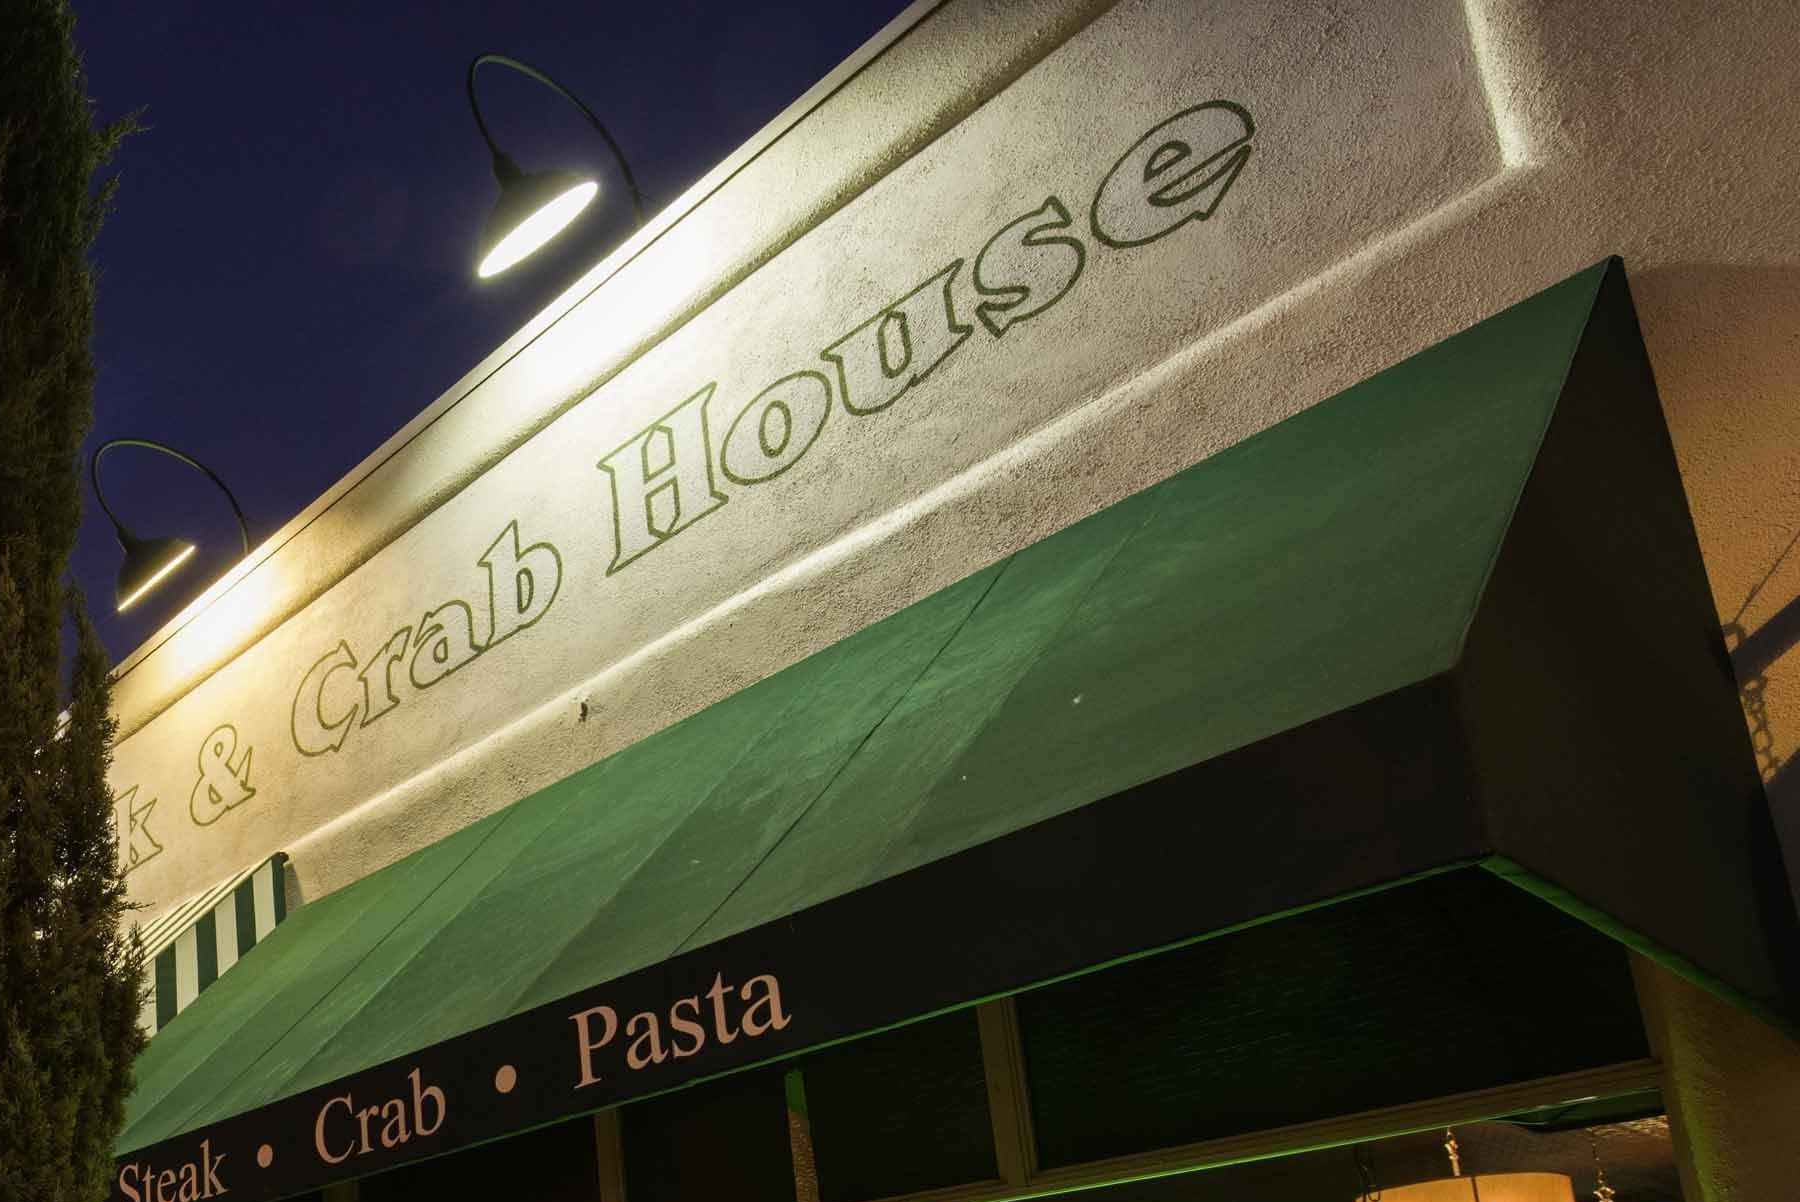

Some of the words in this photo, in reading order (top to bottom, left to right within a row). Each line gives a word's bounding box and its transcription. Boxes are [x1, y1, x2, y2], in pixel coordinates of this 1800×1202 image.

[190, 724, 256, 826] &
[291, 519, 563, 758] Crab
[597, 100, 1257, 578] House
[314, 1067, 447, 1165] Crab
[568, 970, 793, 1090] Pasta
